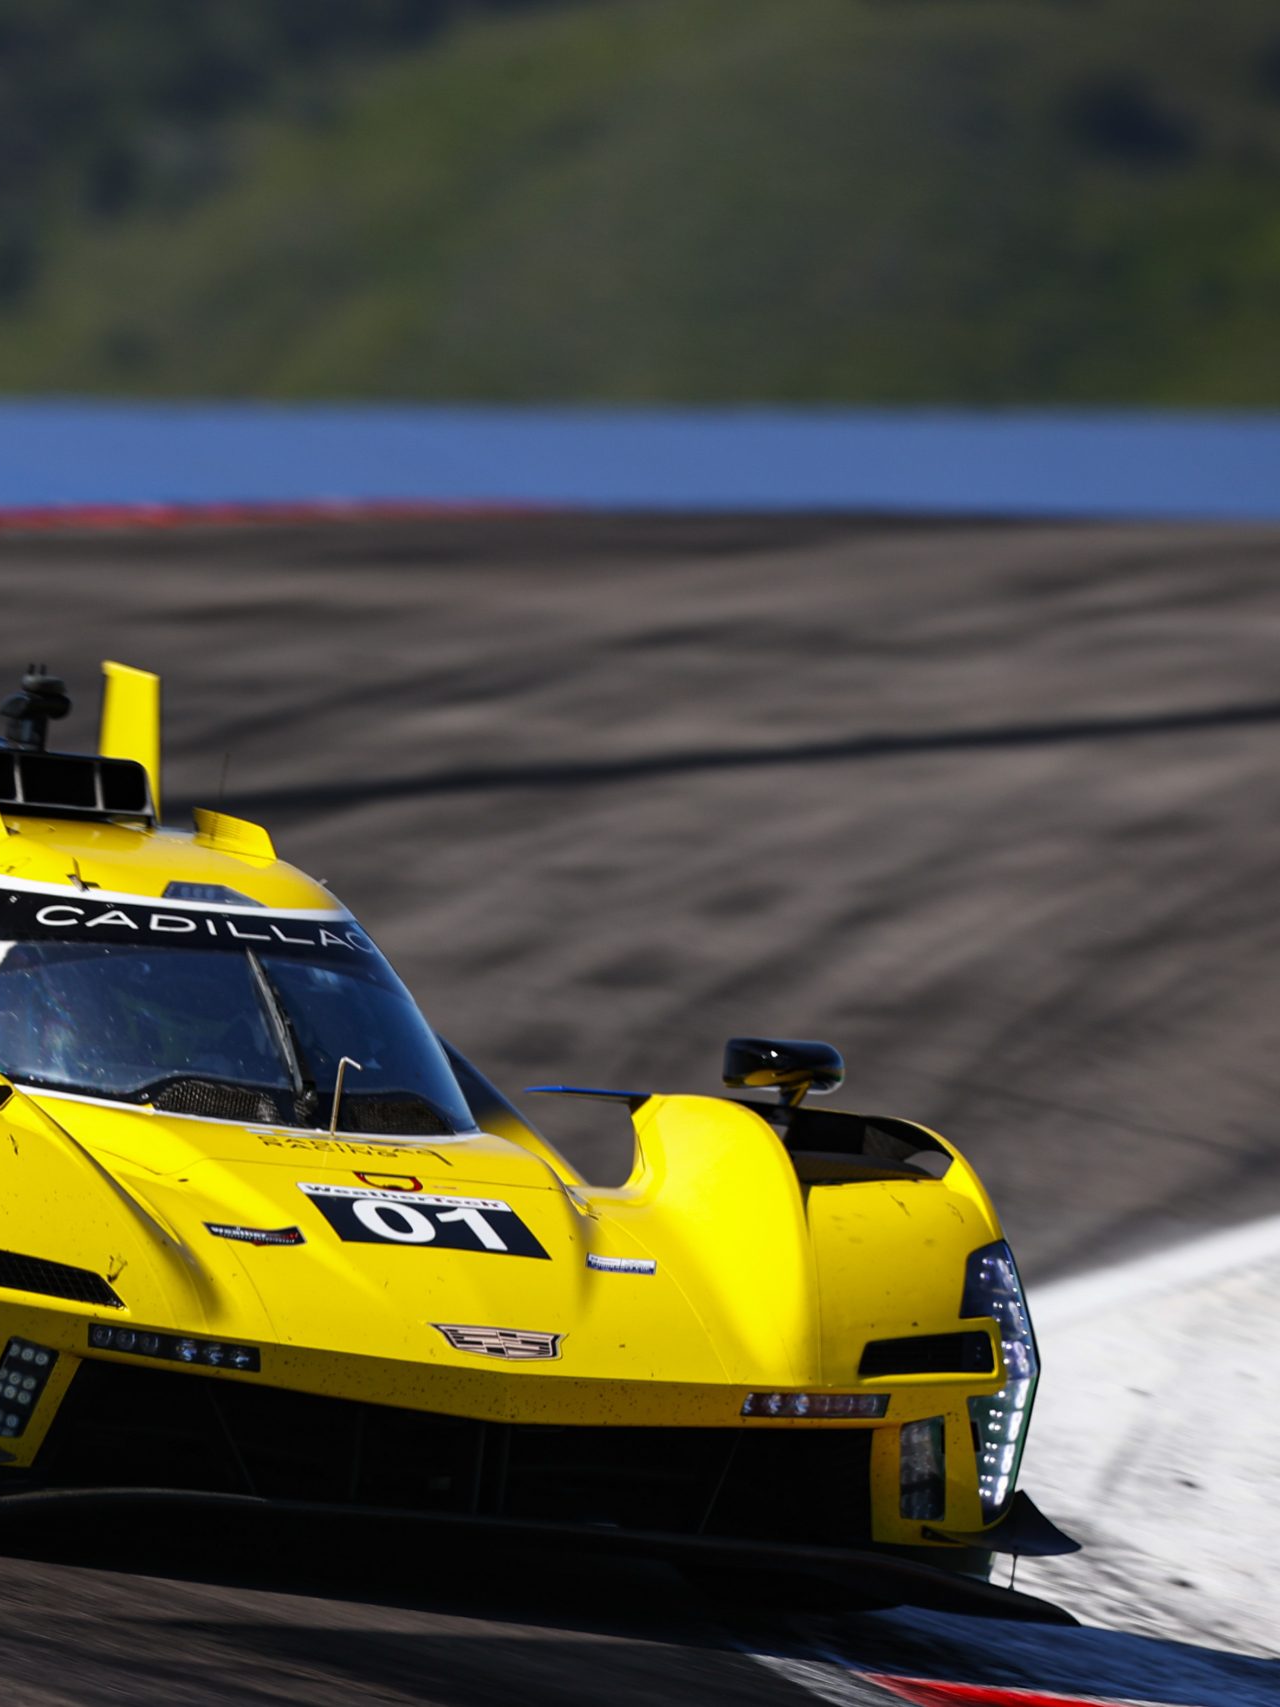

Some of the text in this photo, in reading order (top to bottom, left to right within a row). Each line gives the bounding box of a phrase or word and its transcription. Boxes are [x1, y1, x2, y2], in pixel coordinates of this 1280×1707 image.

[36, 904, 375, 954] CADILLAC
[306, 1184, 501, 1209] WeatherTech
[352, 1199, 508, 1252] 01
